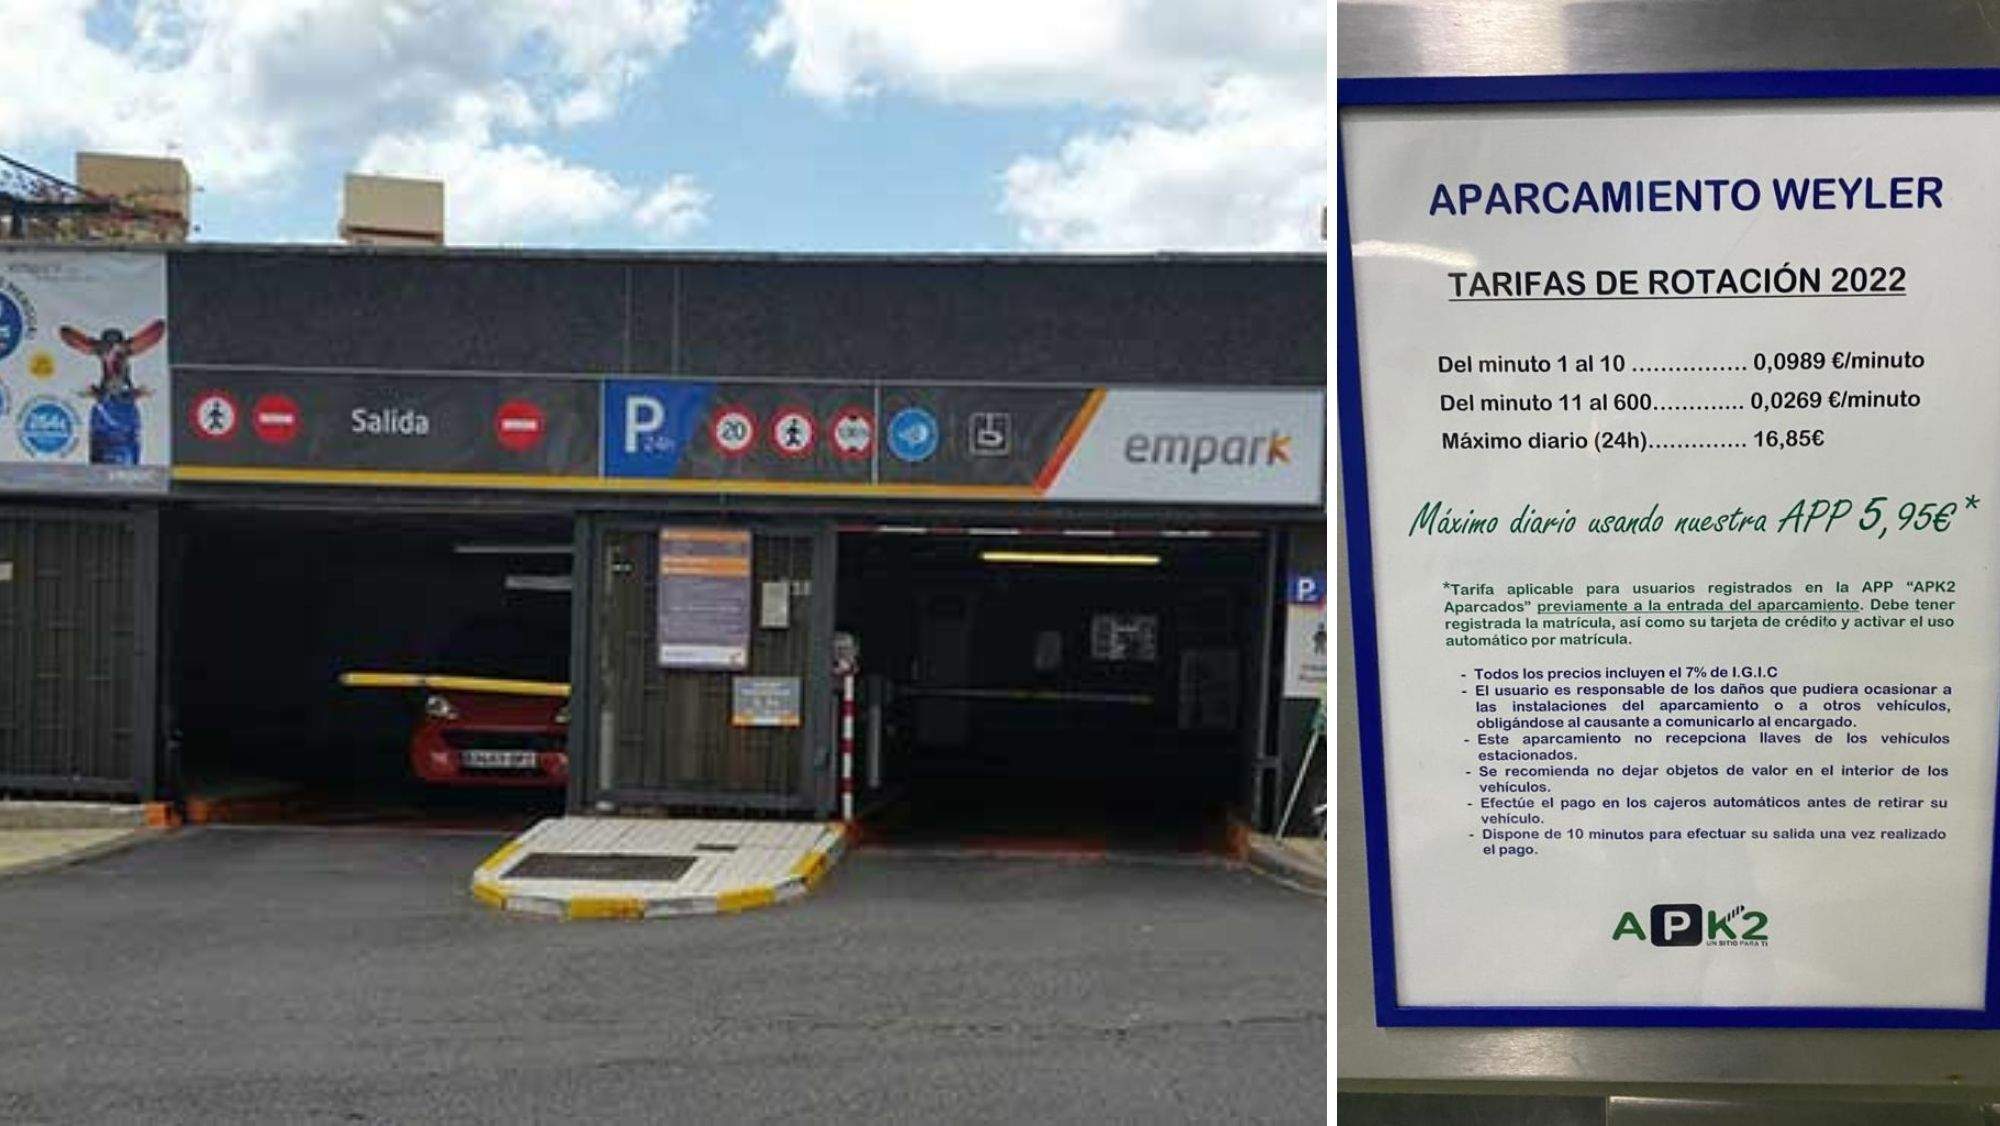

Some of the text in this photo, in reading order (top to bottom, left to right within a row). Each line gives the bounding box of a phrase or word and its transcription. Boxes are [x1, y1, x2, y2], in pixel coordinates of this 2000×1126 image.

[1430, 176, 1943, 216] APARCAMIENTO WEYLER
[1447, 263, 1906, 297] TARIFAS DE ROTACIÓN 2022
[1438, 351, 1925, 376] Del minuto 1 al 10 0,0989 €/minuto
[1441, 394, 1474, 411] Del
[1481, 394, 1552, 411] minuto
[1559, 394, 1581, 411] 11
[1590, 393, 1607, 411] al
[1751, 391, 1822, 412] 0,0269
[1827, 390, 1920, 408] €/minuto
[351, 407, 430, 435] Salida
[625, 395, 664, 454] P
[721, 422, 748, 440] 20
[1442, 432, 1522, 449] Máximo
[1528, 432, 1588, 449] diario
[1754, 429, 1824, 450] 16,85€
[1124, 428, 1292, 474] empark
[1409, 501, 1498, 537] Máximo
[1510, 504, 1576, 534] diario
[1588, 503, 1664, 534] usando
[1674, 507, 1767, 534] nuestra
[1777, 498, 1852, 533] APP
[1297, 578, 1316, 601] P
[1506, 583, 1573, 598] aplicable
[1586, 585, 1619, 597] para
[1633, 582, 1695, 599] usuarios
[1708, 581, 1792, 596] registrados
[1805, 584, 1823, 593] en
[1836, 581, 1849, 593] la
[1862, 581, 1893, 593] APP
[1537, 601, 1628, 615] previamente
[1633, 603, 1643, 612] a
[1648, 600, 1662, 612] la
[1667, 599, 1724, 612] entrada
[1729, 599, 1751, 612] del
[1757, 599, 1864, 615] aparcamiento.
[1870, 598, 1909, 611] Debe
[1915, 600, 1956, 611] tener
[1445, 615, 1954, 633] registrada la matrícula, así como su tarjeta de crédito y activar el uso
[1446, 632, 1632, 648] automático por matrícula.
[1474, 666, 1778, 681] Todos los precios incluyen el 7% de I.G.I.C
[1476, 682, 1952, 698] El usuario es responsable de los daños que pudiera ocasionar a
[1476, 699, 1950, 714] las instalaciones del aparcamiento o a otros vehículos,
[1477, 714, 1857, 731] obligándose al causante a comunicarlo al encargado.
[1478, 732, 1950, 747] Este aparcamiento no recepciona llaves de los vehículos
[1478, 749, 1577, 761] estacionados.
[1479, 764, 1948, 779] Se recomienda no dejar objetos de valor en el interior de los
[1479, 781, 1551, 793] vehículos.
[1481, 795, 1947, 811] Efectúe el pago en los cajeros automáticos antes de retirar su
[1481, 813, 1544, 826] vehículo.
[1482, 828, 1946, 842] Dispone de 10 minutos para efectuar su salida una vez realizado
[1483, 844, 1538, 857] el pago.
